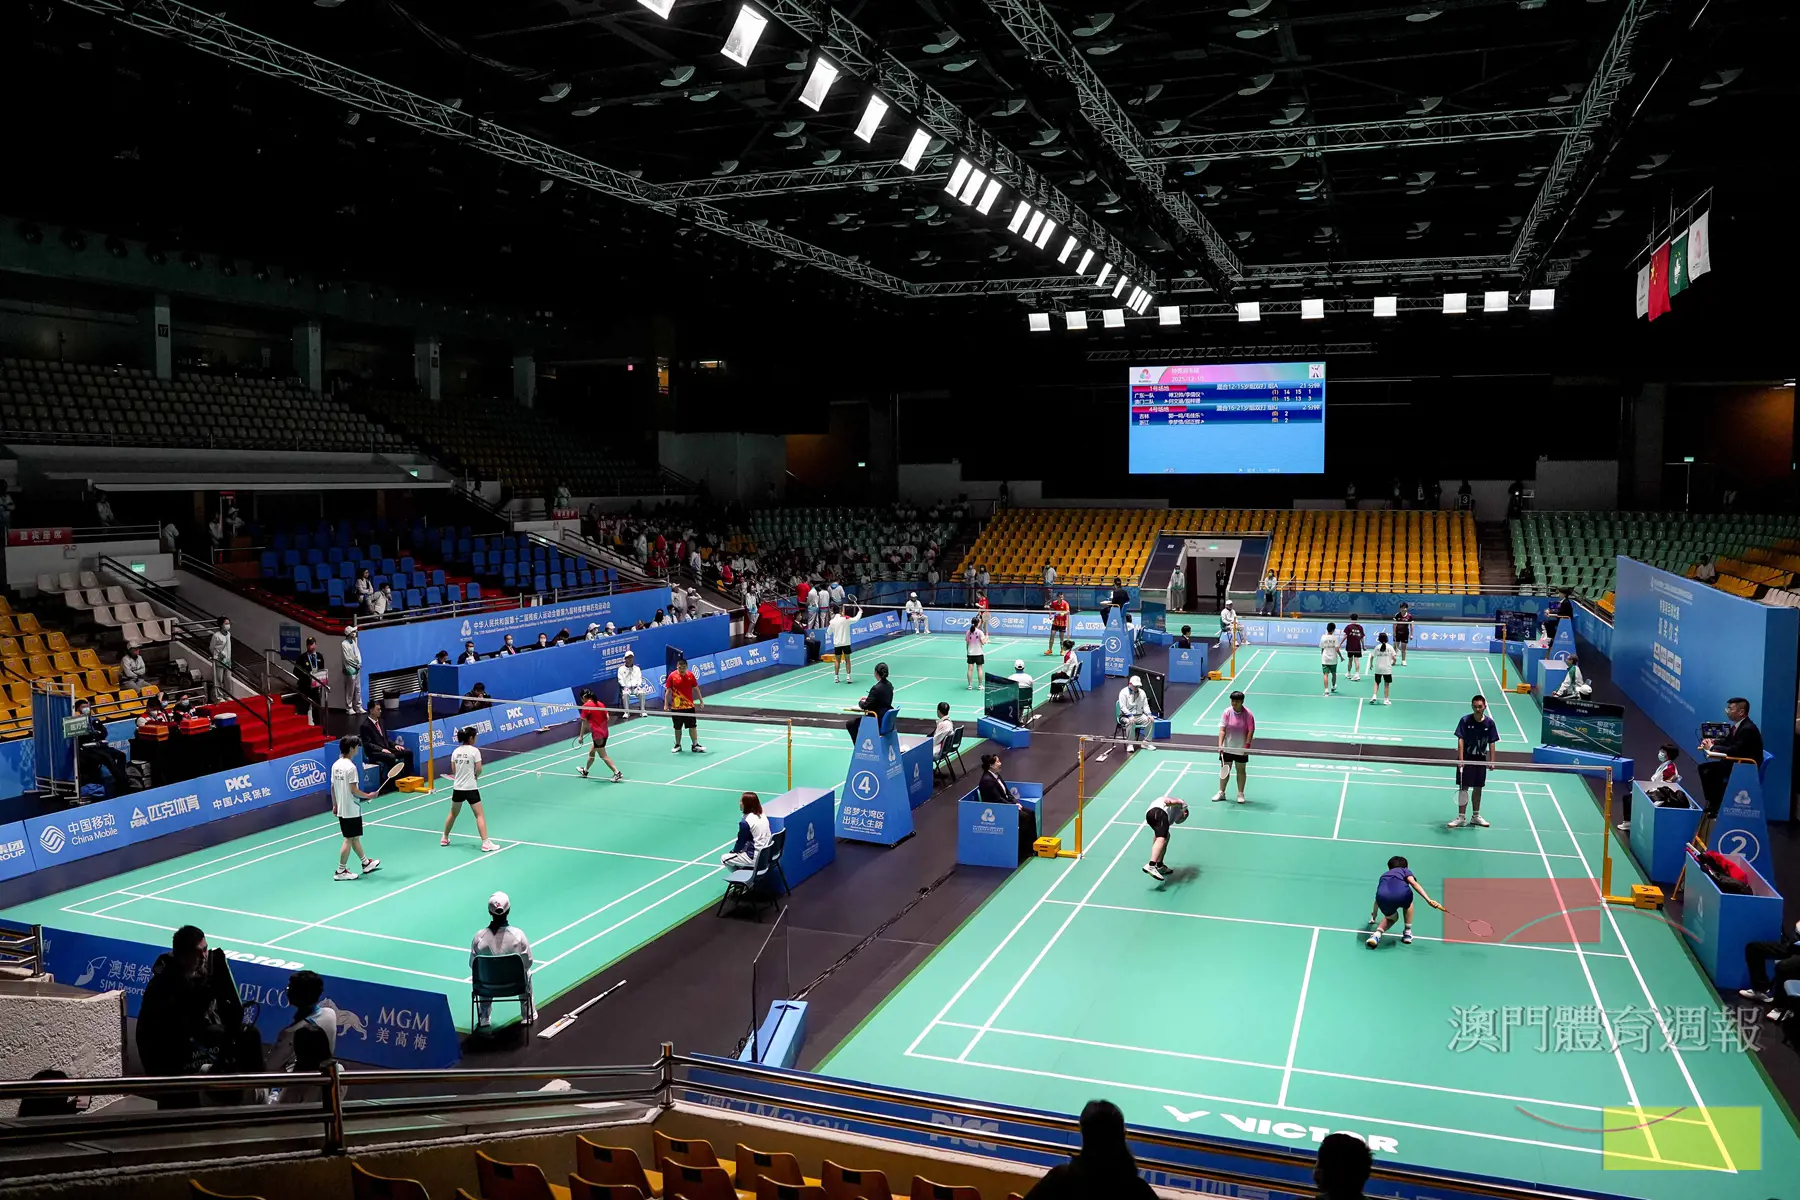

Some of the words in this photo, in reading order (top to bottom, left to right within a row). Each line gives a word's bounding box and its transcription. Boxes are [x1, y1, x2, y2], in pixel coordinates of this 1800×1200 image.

[159, 326, 168, 336] 17
[1462, 496, 1468, 504] 3
[1524, 630, 1530, 638] 3
[1109, 638, 1117, 649] 3
[506, 706, 524, 720] PICC
[292, 762, 317, 776] 百岁山
[224, 774, 252, 792] PICC
[858, 776, 871, 794] 4
[212, 786, 272, 810] 中国人民保险
[146, 794, 200, 822] 匹克体育
[843, 806, 886, 820] 追梦大湾区
[67, 812, 116, 836] 中国移动
[130, 816, 149, 830] PEAK
[842, 816, 884, 830] 出彩人生路
[71, 833, 94, 846] China
[94, 826, 118, 841] Mobile
[1730, 836, 1747, 858] 2
[100, 978, 116, 992] SJM
[377, 1006, 430, 1033] MGM
[930, 1112, 1000, 1151] PICC
